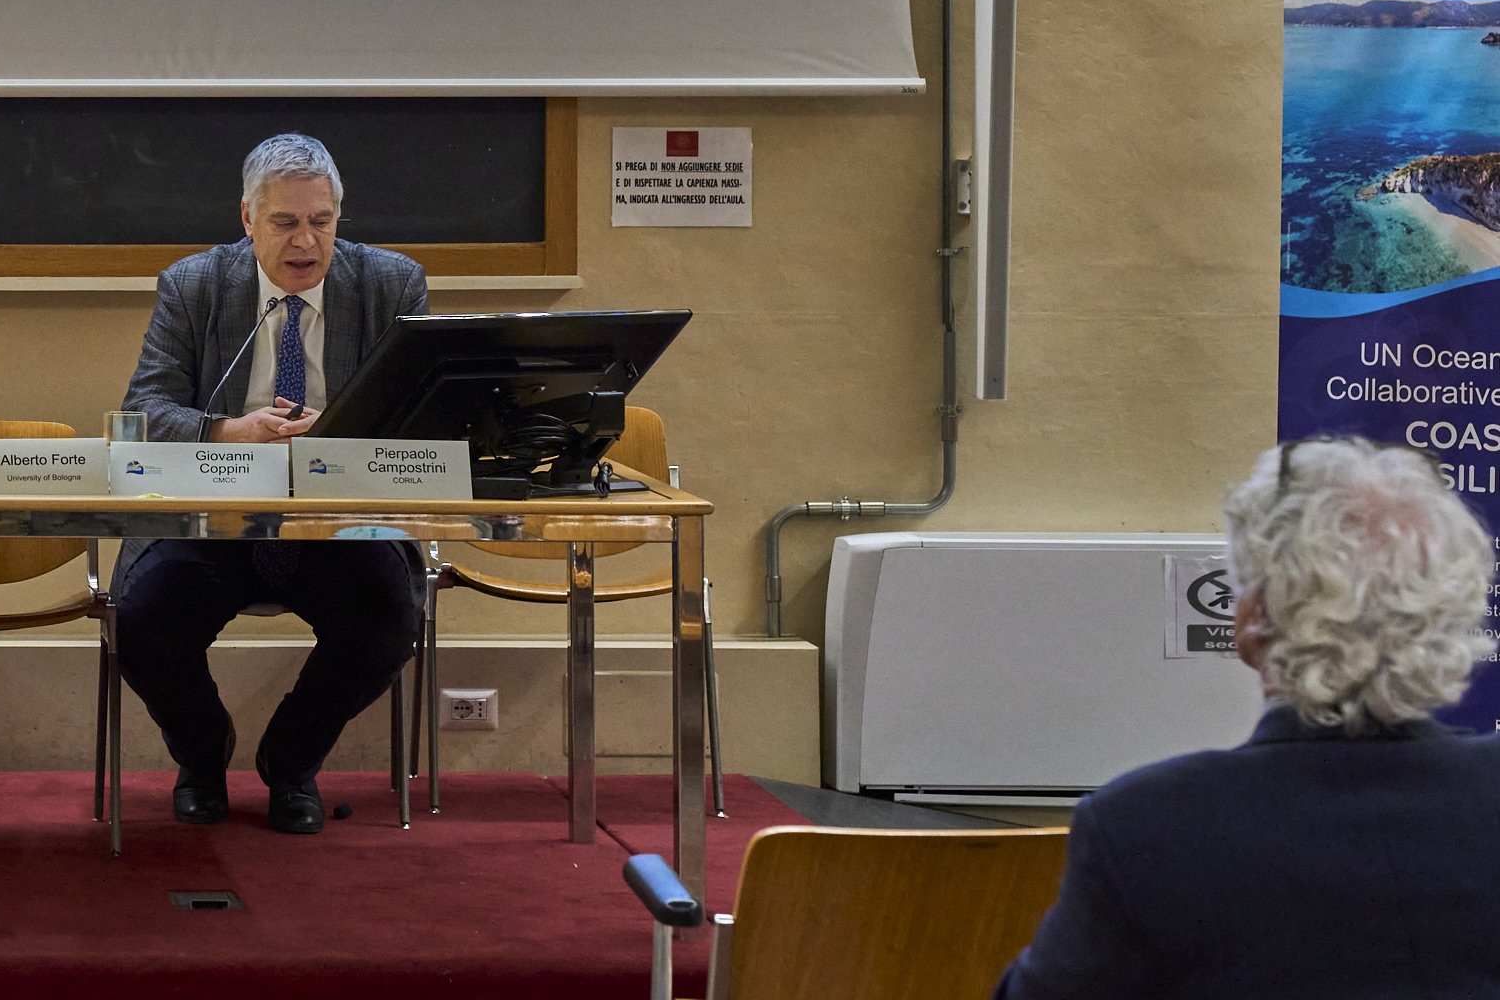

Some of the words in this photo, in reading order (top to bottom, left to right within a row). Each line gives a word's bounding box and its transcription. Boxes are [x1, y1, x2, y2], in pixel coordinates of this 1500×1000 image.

[616, 162, 622, 172] SI
[625, 162, 647, 172] PREGA
[650, 162, 658, 172] DI
[661, 162, 676, 172] NON
[678, 162, 721, 172] AGGIUNGERE
[725, 162, 744, 172] SEDIE
[616, 178, 620, 188] E
[624, 178, 631, 188] DI
[634, 178, 672, 188] RISPETTARE
[676, 178, 684, 188] LA
[687, 178, 718, 188] CAPIENZA
[721, 178, 742, 188] MASSI-
[616, 194, 628, 205] MA,
[630, 194, 659, 204] INDICATA
[1360, 342, 1402, 367] UN
[1405, 420, 1500, 451] COAS
[0, 454, 48, 466] Alberto
[52, 454, 86, 465] Forte
[195, 450, 254, 461] Giovanni
[375, 447, 438, 462] Pierpaolo
[200, 463, 250, 476] Coppini
[367, 460, 446, 475] Campostrini
[7, 474, 42, 482] University
[52, 474, 82, 482] Bologna
[212, 476, 237, 484] CMCC
